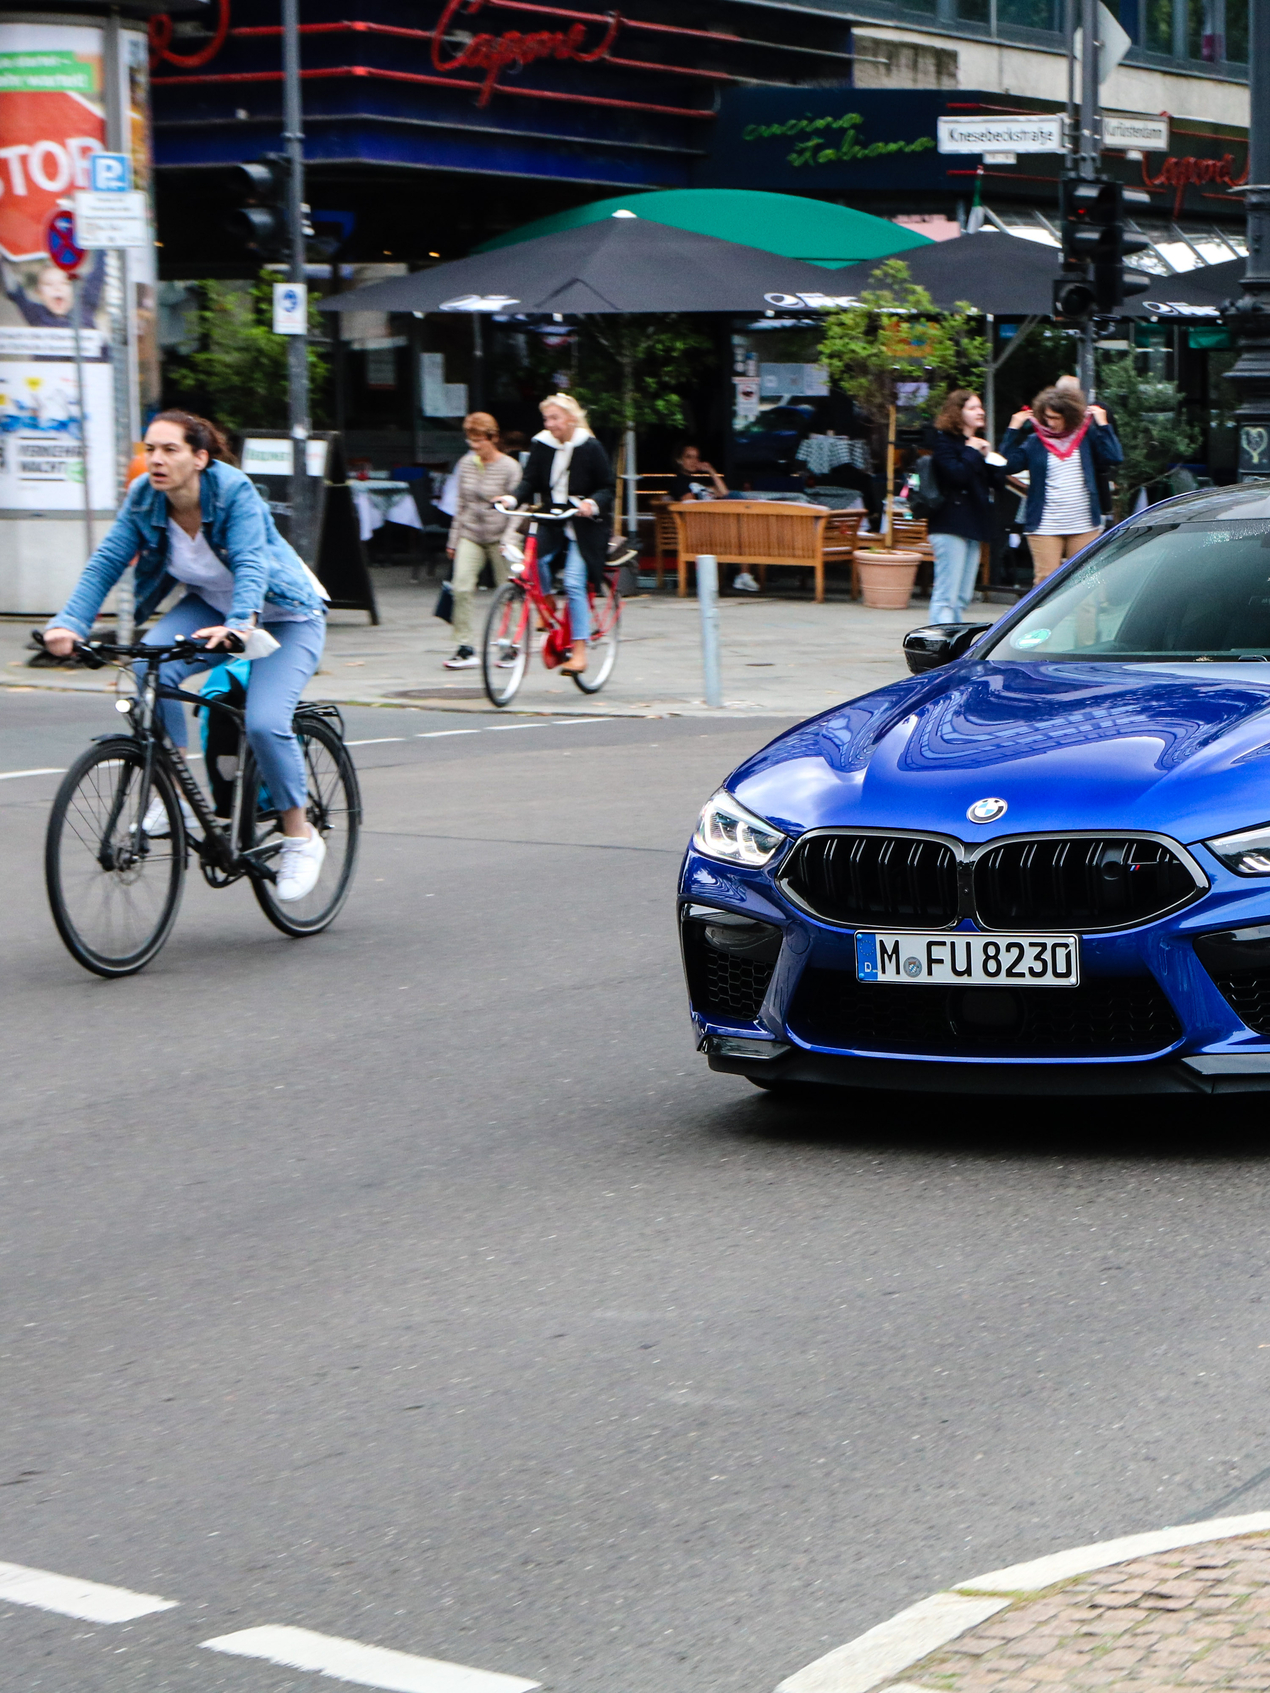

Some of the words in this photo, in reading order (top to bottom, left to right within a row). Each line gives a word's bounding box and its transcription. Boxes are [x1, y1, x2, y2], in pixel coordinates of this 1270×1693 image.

[948, 127, 1054, 146] Knesebeckstraße
[0, 137, 108, 196] TOP
[879, 939, 900, 975] M
[926, 940, 973, 977] FU
[982, 941, 1072, 978] 8230
